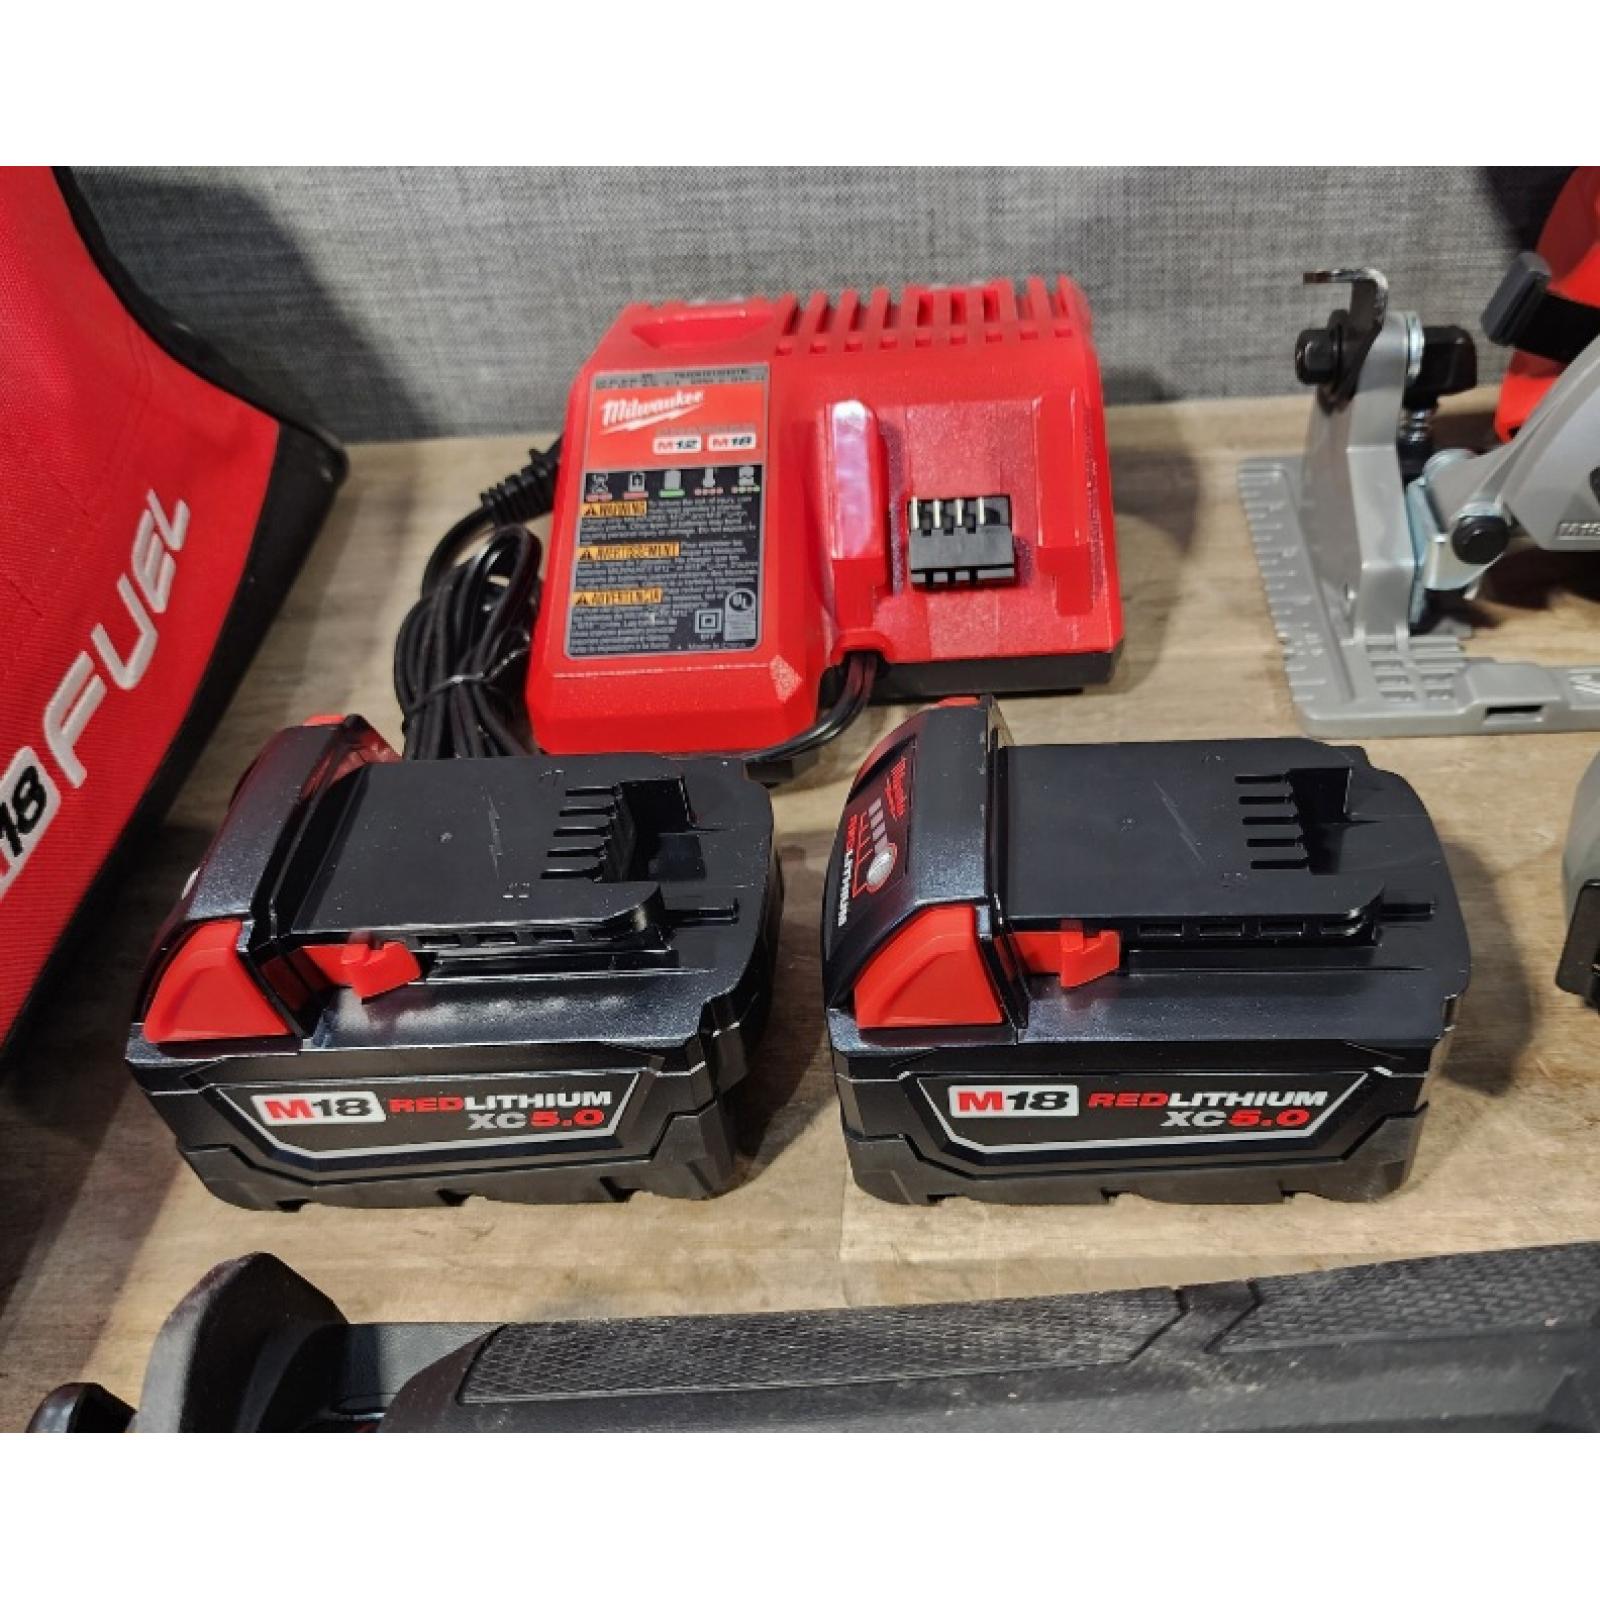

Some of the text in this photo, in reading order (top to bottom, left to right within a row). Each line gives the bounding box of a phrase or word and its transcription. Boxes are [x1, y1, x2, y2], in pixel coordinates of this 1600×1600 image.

[602, 391, 704, 427] Milwaukee
[0, 488, 190, 880] 18 FUEL
[264, 1091, 611, 1119] M18 REDLITHIUM
[957, 1090, 1329, 1112] M18 REDLITHIUM
